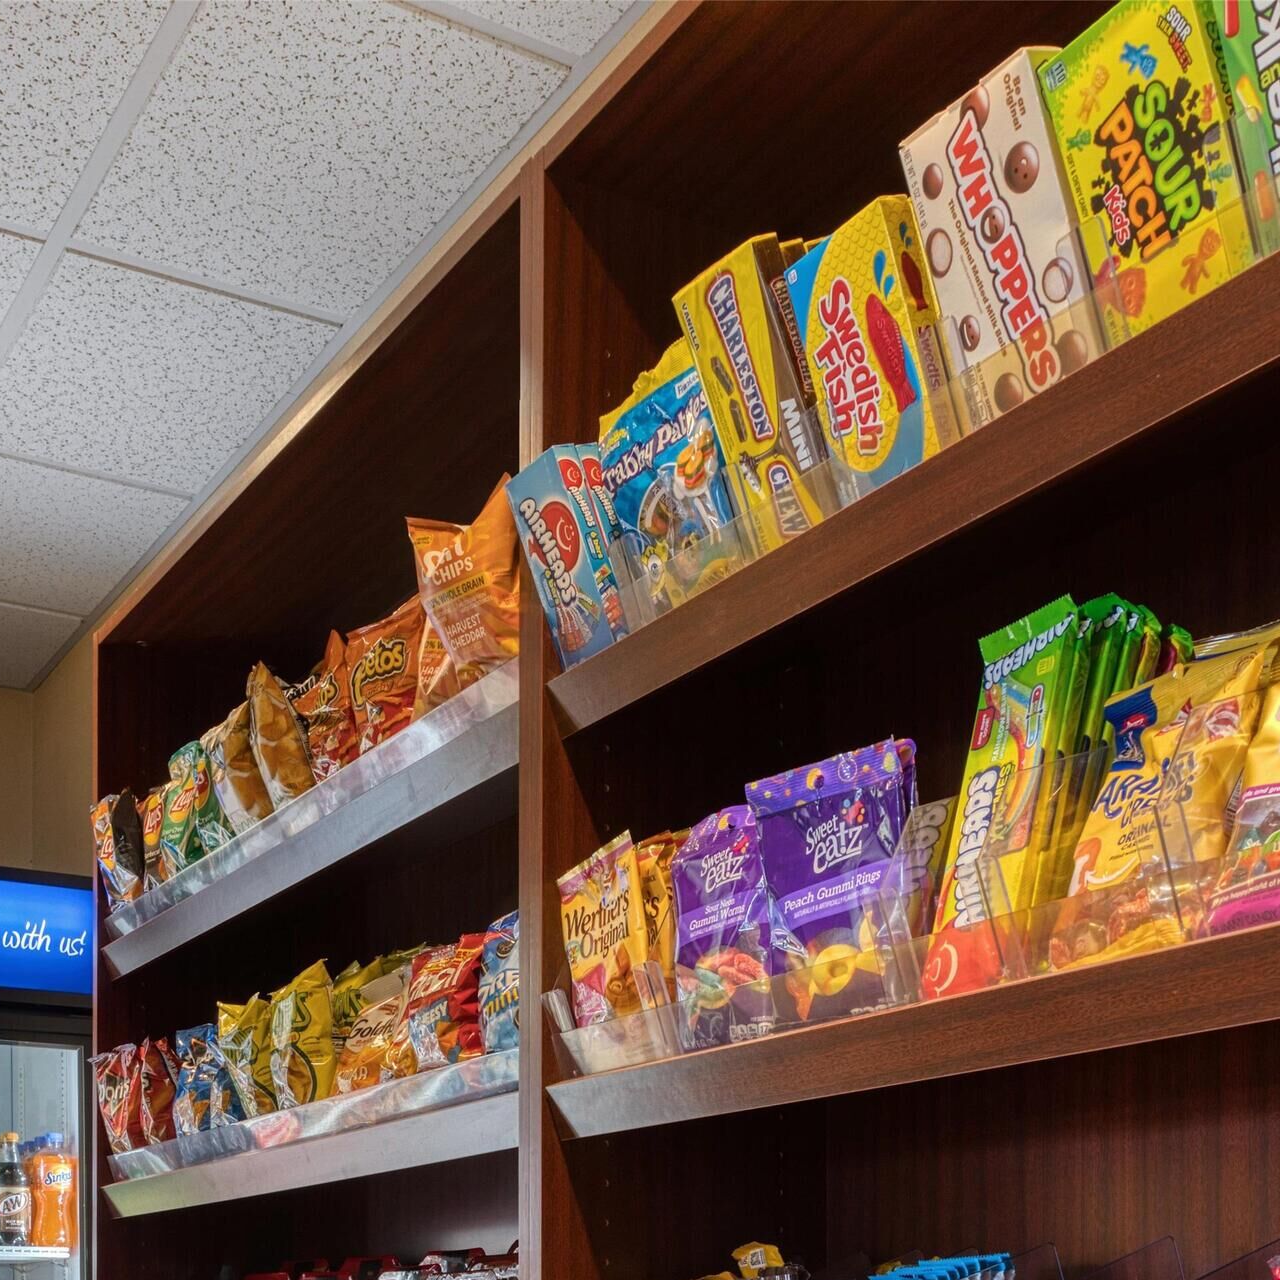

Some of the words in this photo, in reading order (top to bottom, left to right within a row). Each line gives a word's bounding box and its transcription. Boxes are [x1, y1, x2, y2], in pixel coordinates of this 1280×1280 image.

[1167, 5, 1192, 41] SOUR
[1003, 74, 1022, 131] Original
[1098, 98, 1172, 261] PATCH
[1133, 80, 1202, 231] SOUR
[1103, 185, 1131, 246] Kids
[950, 118, 1058, 389] WHOPPERS
[682, 304, 700, 351] VANILLA
[708, 271, 772, 441] CHARLESTON
[819, 280, 884, 455] Swedish
[815, 331, 854, 437] Fish
[781, 398, 813, 470] MINI
[568, 485, 597, 528] AIRHEADS
[591, 484, 619, 527] AIRHEADS
[769, 463, 814, 535] CHEW
[433, 555, 474, 586] CHIPS
[519, 497, 577, 608] AIRHEADS
[445, 612, 482, 639] HARVEST
[450, 626, 487, 651] CHEDDAR
[984, 612, 1075, 690] AIRHEADS
[806, 814, 840, 856] Sweet
[954, 766, 1001, 929] AIRHEADS
[565, 889, 630, 940] Werther's
[689, 913, 720, 932] Gummi
[719, 904, 746, 923] Worms
[783, 890, 815, 915] Peach
[816, 879, 855, 900] Gummi
[855, 869, 882, 887] Rings
[1, 918, 51, 953] with
[580, 914, 630, 959] Original
